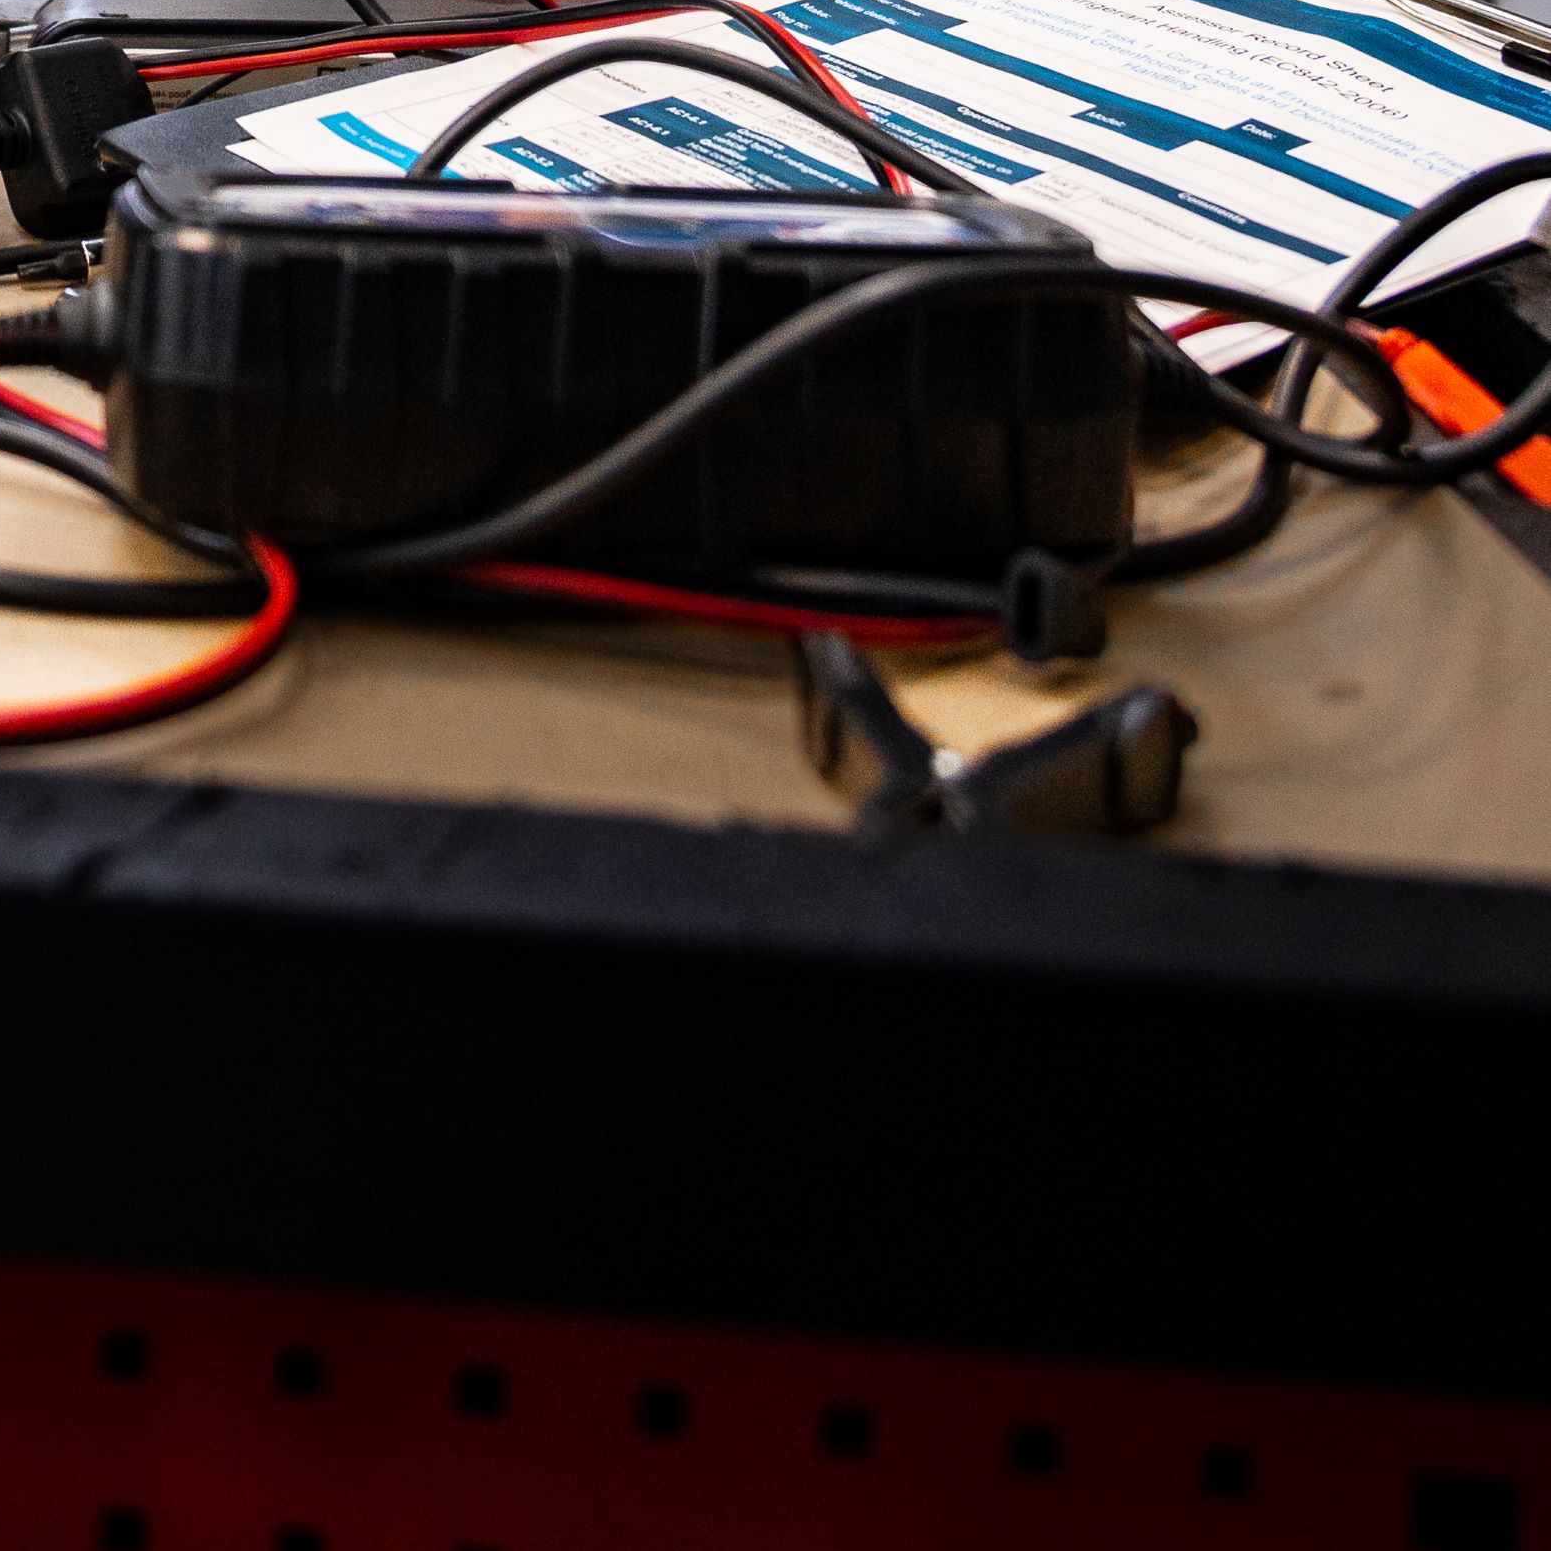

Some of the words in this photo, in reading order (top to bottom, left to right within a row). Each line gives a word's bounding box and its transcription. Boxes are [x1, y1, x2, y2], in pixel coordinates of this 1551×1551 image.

[772, 10, 796, 24] Reg
[800, 2, 832, 19] Make:
[863, 9, 900, 26] details:
[892, 3, 925, 17] name:
[1099, 28, 1138, 45] Task
[1166, 51, 1211, 70] Carry
[1216, 67, 1250, 82] Out
[1250, 81, 1275, 91] an
[1147, 5, 1244, 35] Assessor
[1245, 32, 1326, 61] Record
[1327, 60, 1394, 93] Sheet
[819, 53, 884, 80] Assessment
[1090, 38, 1190, 75] Greenhouse
[1193, 72, 1250, 95] Gases
[1251, 93, 1290, 109] and
[1122, 61, 1198, 91] Handling
[1157, 22, 1249, 56] Handling
[1250, 53, 1409, 119] (EC842-2006)
[957, 106, 1012, 132] Operation
[1085, 111, 1127, 127] Model:
[1242, 123, 1277, 140] Date:
[1177, 192, 1247, 225] Comments
